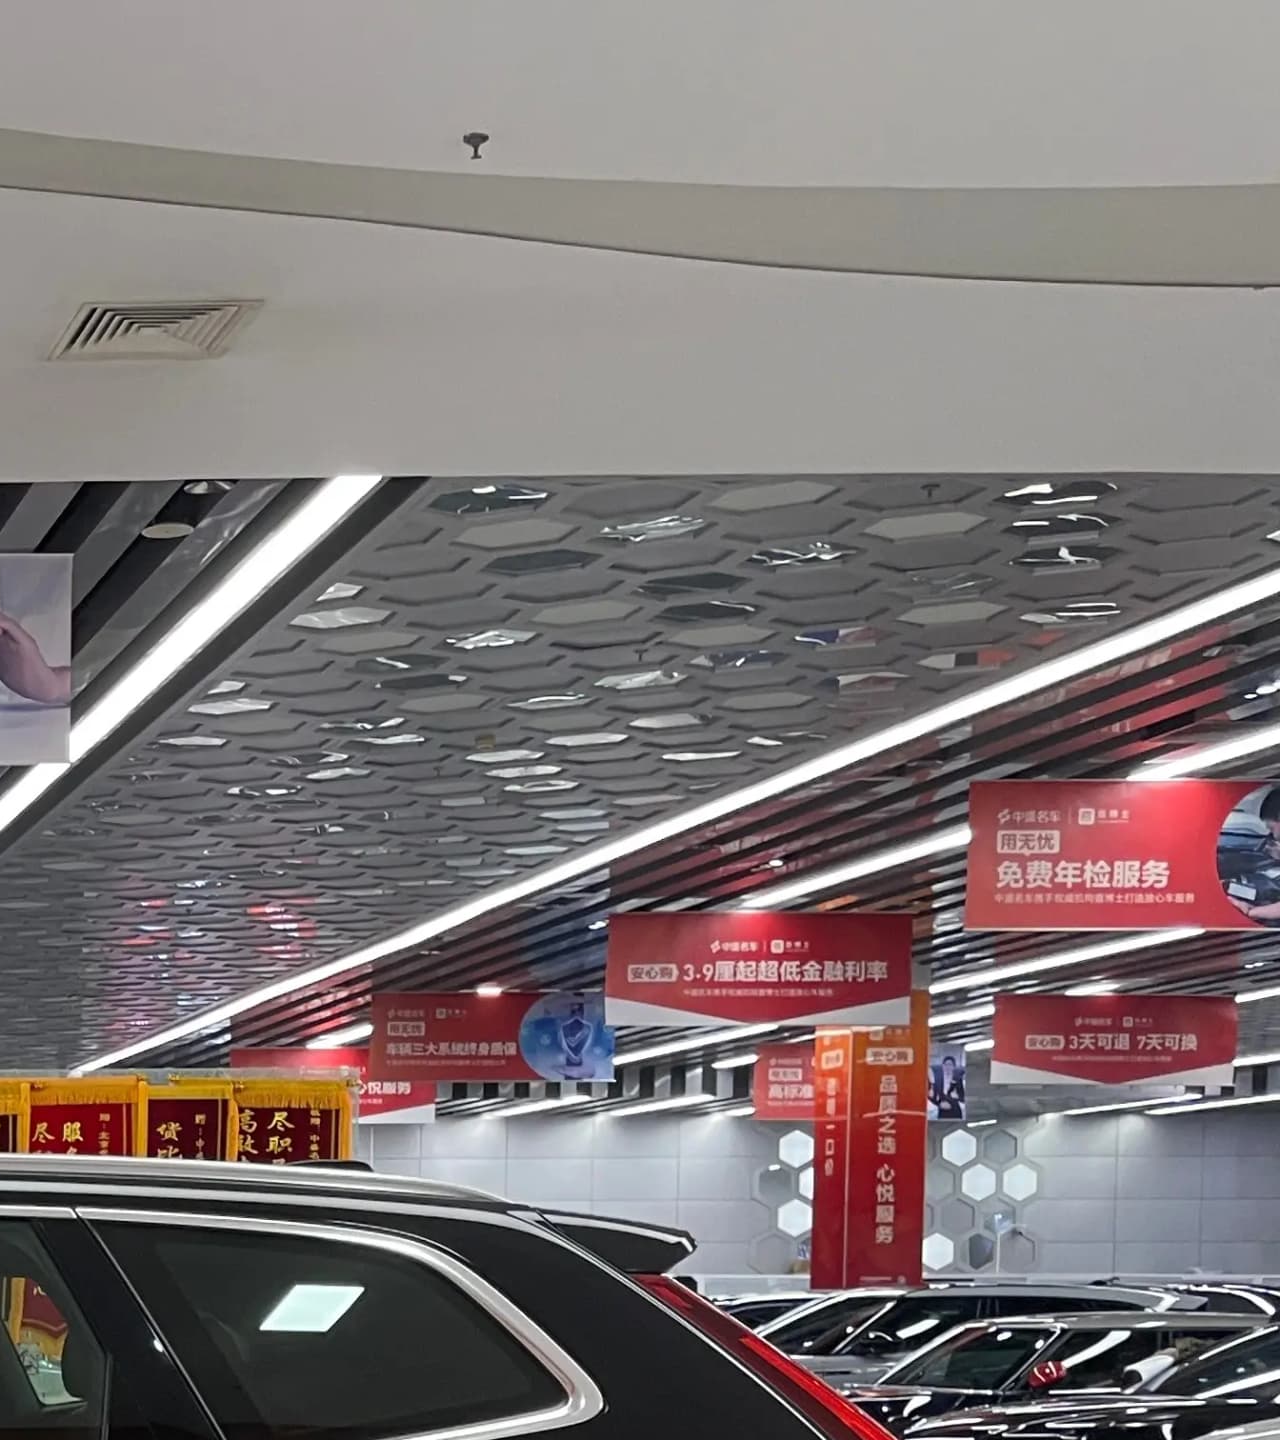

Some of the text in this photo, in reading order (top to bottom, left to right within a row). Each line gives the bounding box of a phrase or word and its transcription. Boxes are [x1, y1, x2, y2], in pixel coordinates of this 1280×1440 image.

[1000, 833, 1056, 850] 用无忧
[996, 861, 1170, 888] 免费年检服务
[683, 960, 888, 982] 3.9厘起超低金融利率
[1069, 1034, 1129, 1051] 3天可退
[1138, 1034, 1198, 1051] 7天可换
